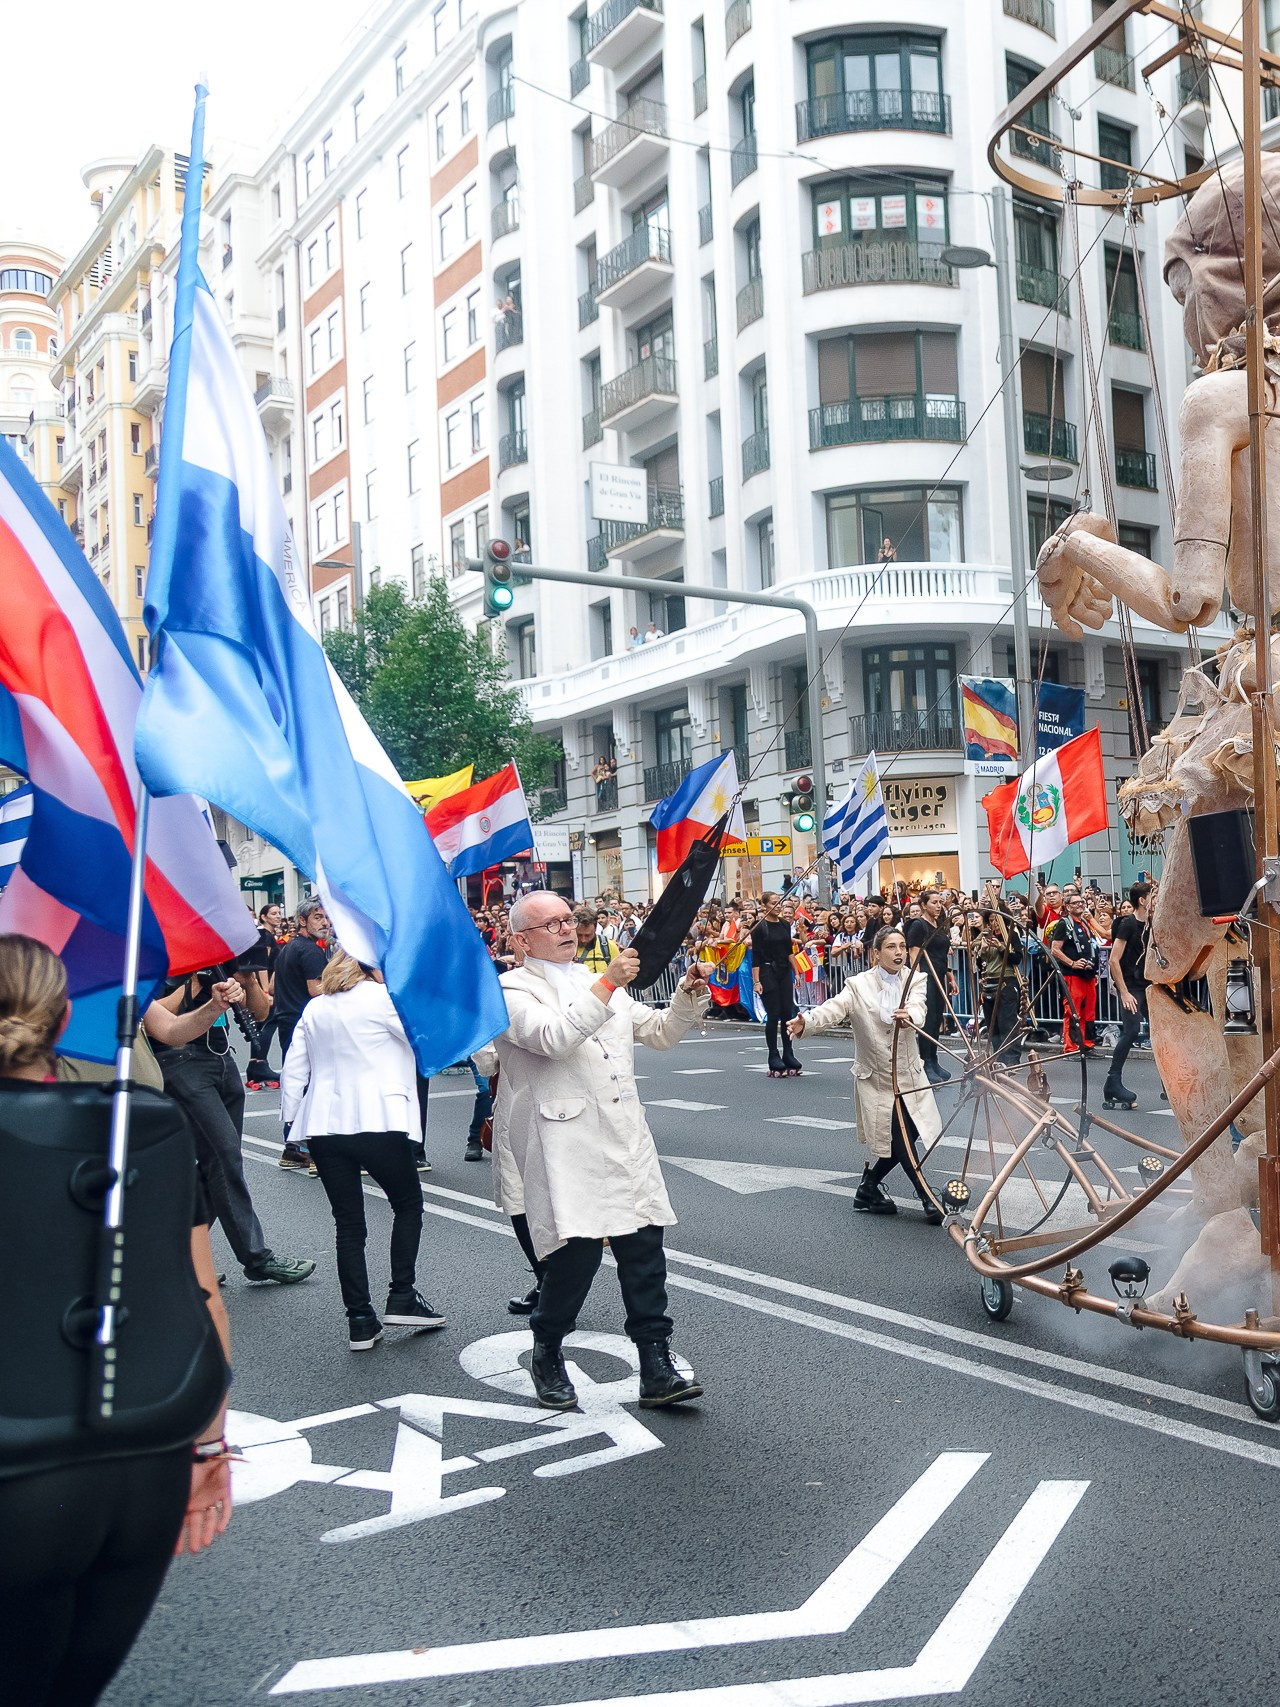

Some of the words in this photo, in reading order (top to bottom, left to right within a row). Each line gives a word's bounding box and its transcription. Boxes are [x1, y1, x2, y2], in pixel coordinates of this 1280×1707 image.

[1038, 711, 1060, 723] FIESTA
[1038, 723, 1074, 737] NACIONAL
[980, 765, 1005, 774] MADRID
[883, 782, 948, 804] flying
[888, 802, 944, 822] tiger
[888, 822, 946, 833] copenhagen
